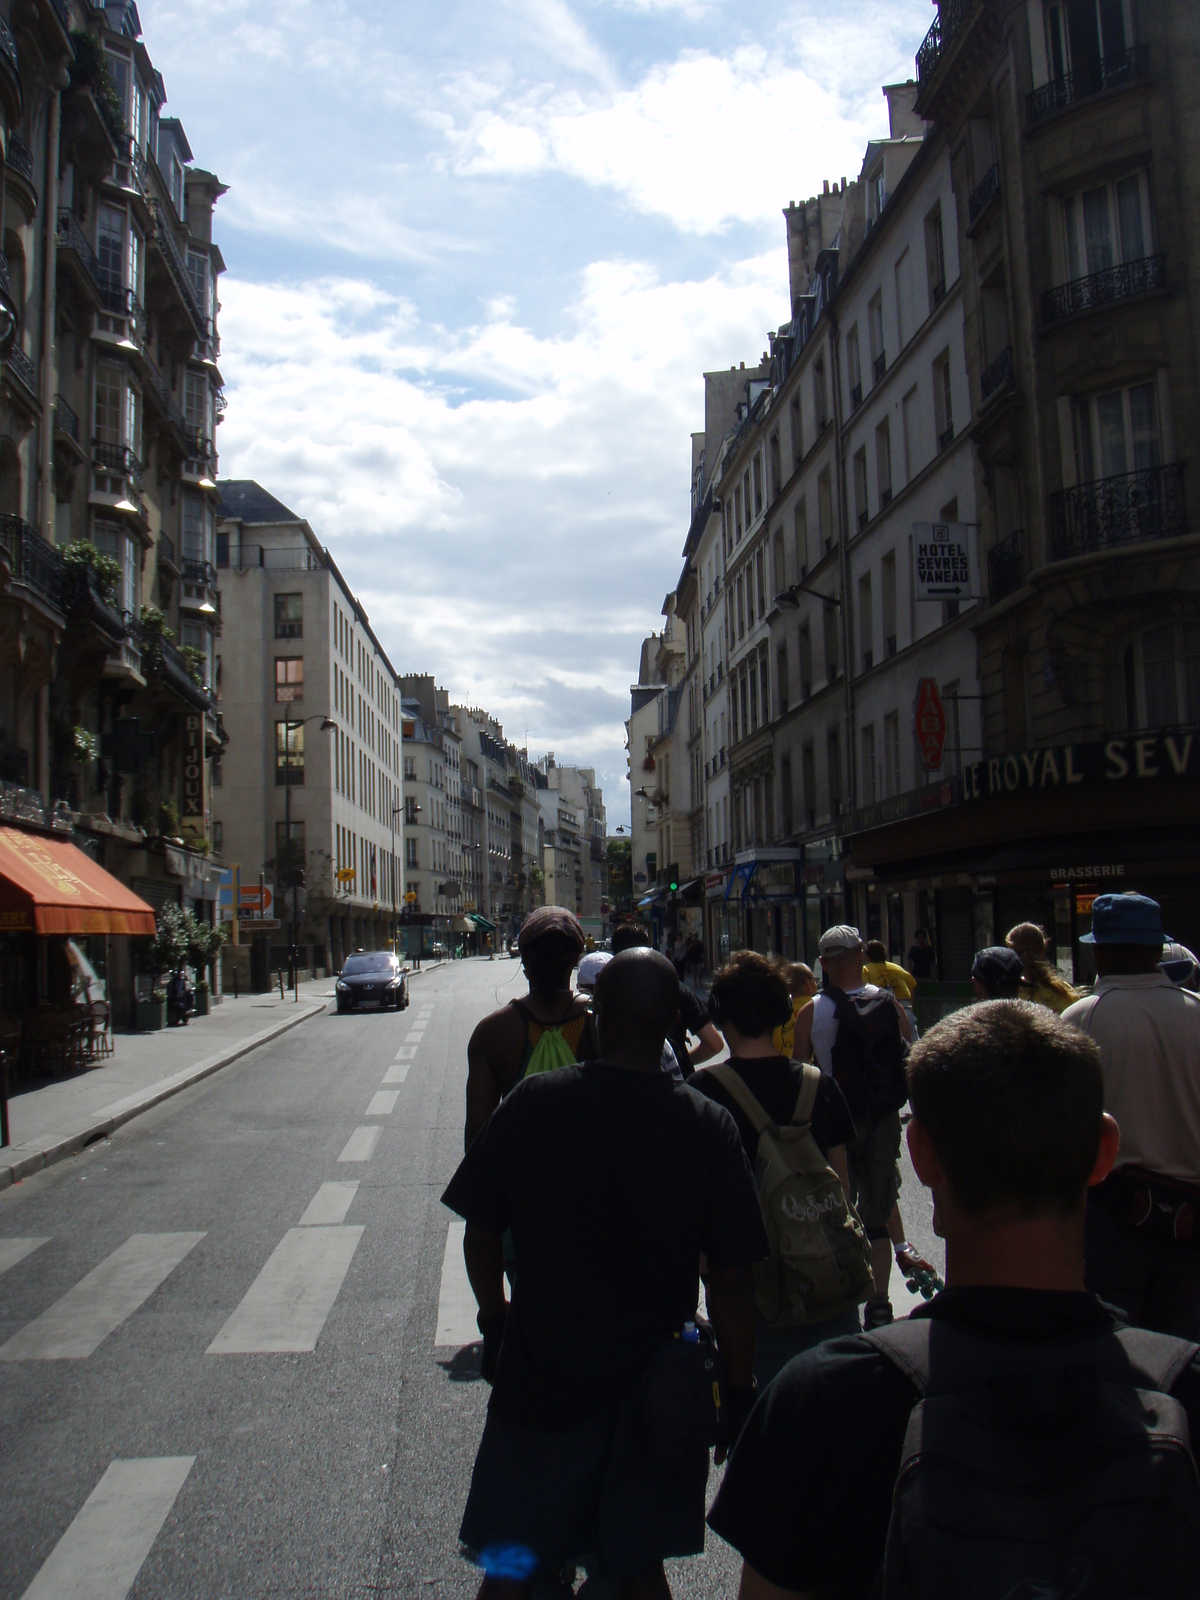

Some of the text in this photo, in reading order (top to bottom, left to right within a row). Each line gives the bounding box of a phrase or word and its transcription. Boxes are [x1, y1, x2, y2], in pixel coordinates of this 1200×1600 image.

[918, 543, 965, 557] HOTEL
[917, 556, 968, 570] SEVRES
[917, 570, 969, 583] VANEAU
[921, 682, 941, 767] TABAC
[185, 716, 200, 813] BIJOUX
[963, 733, 1200, 802] LE ROYAL SEV
[1050, 864, 1126, 880] BRASSERIE
